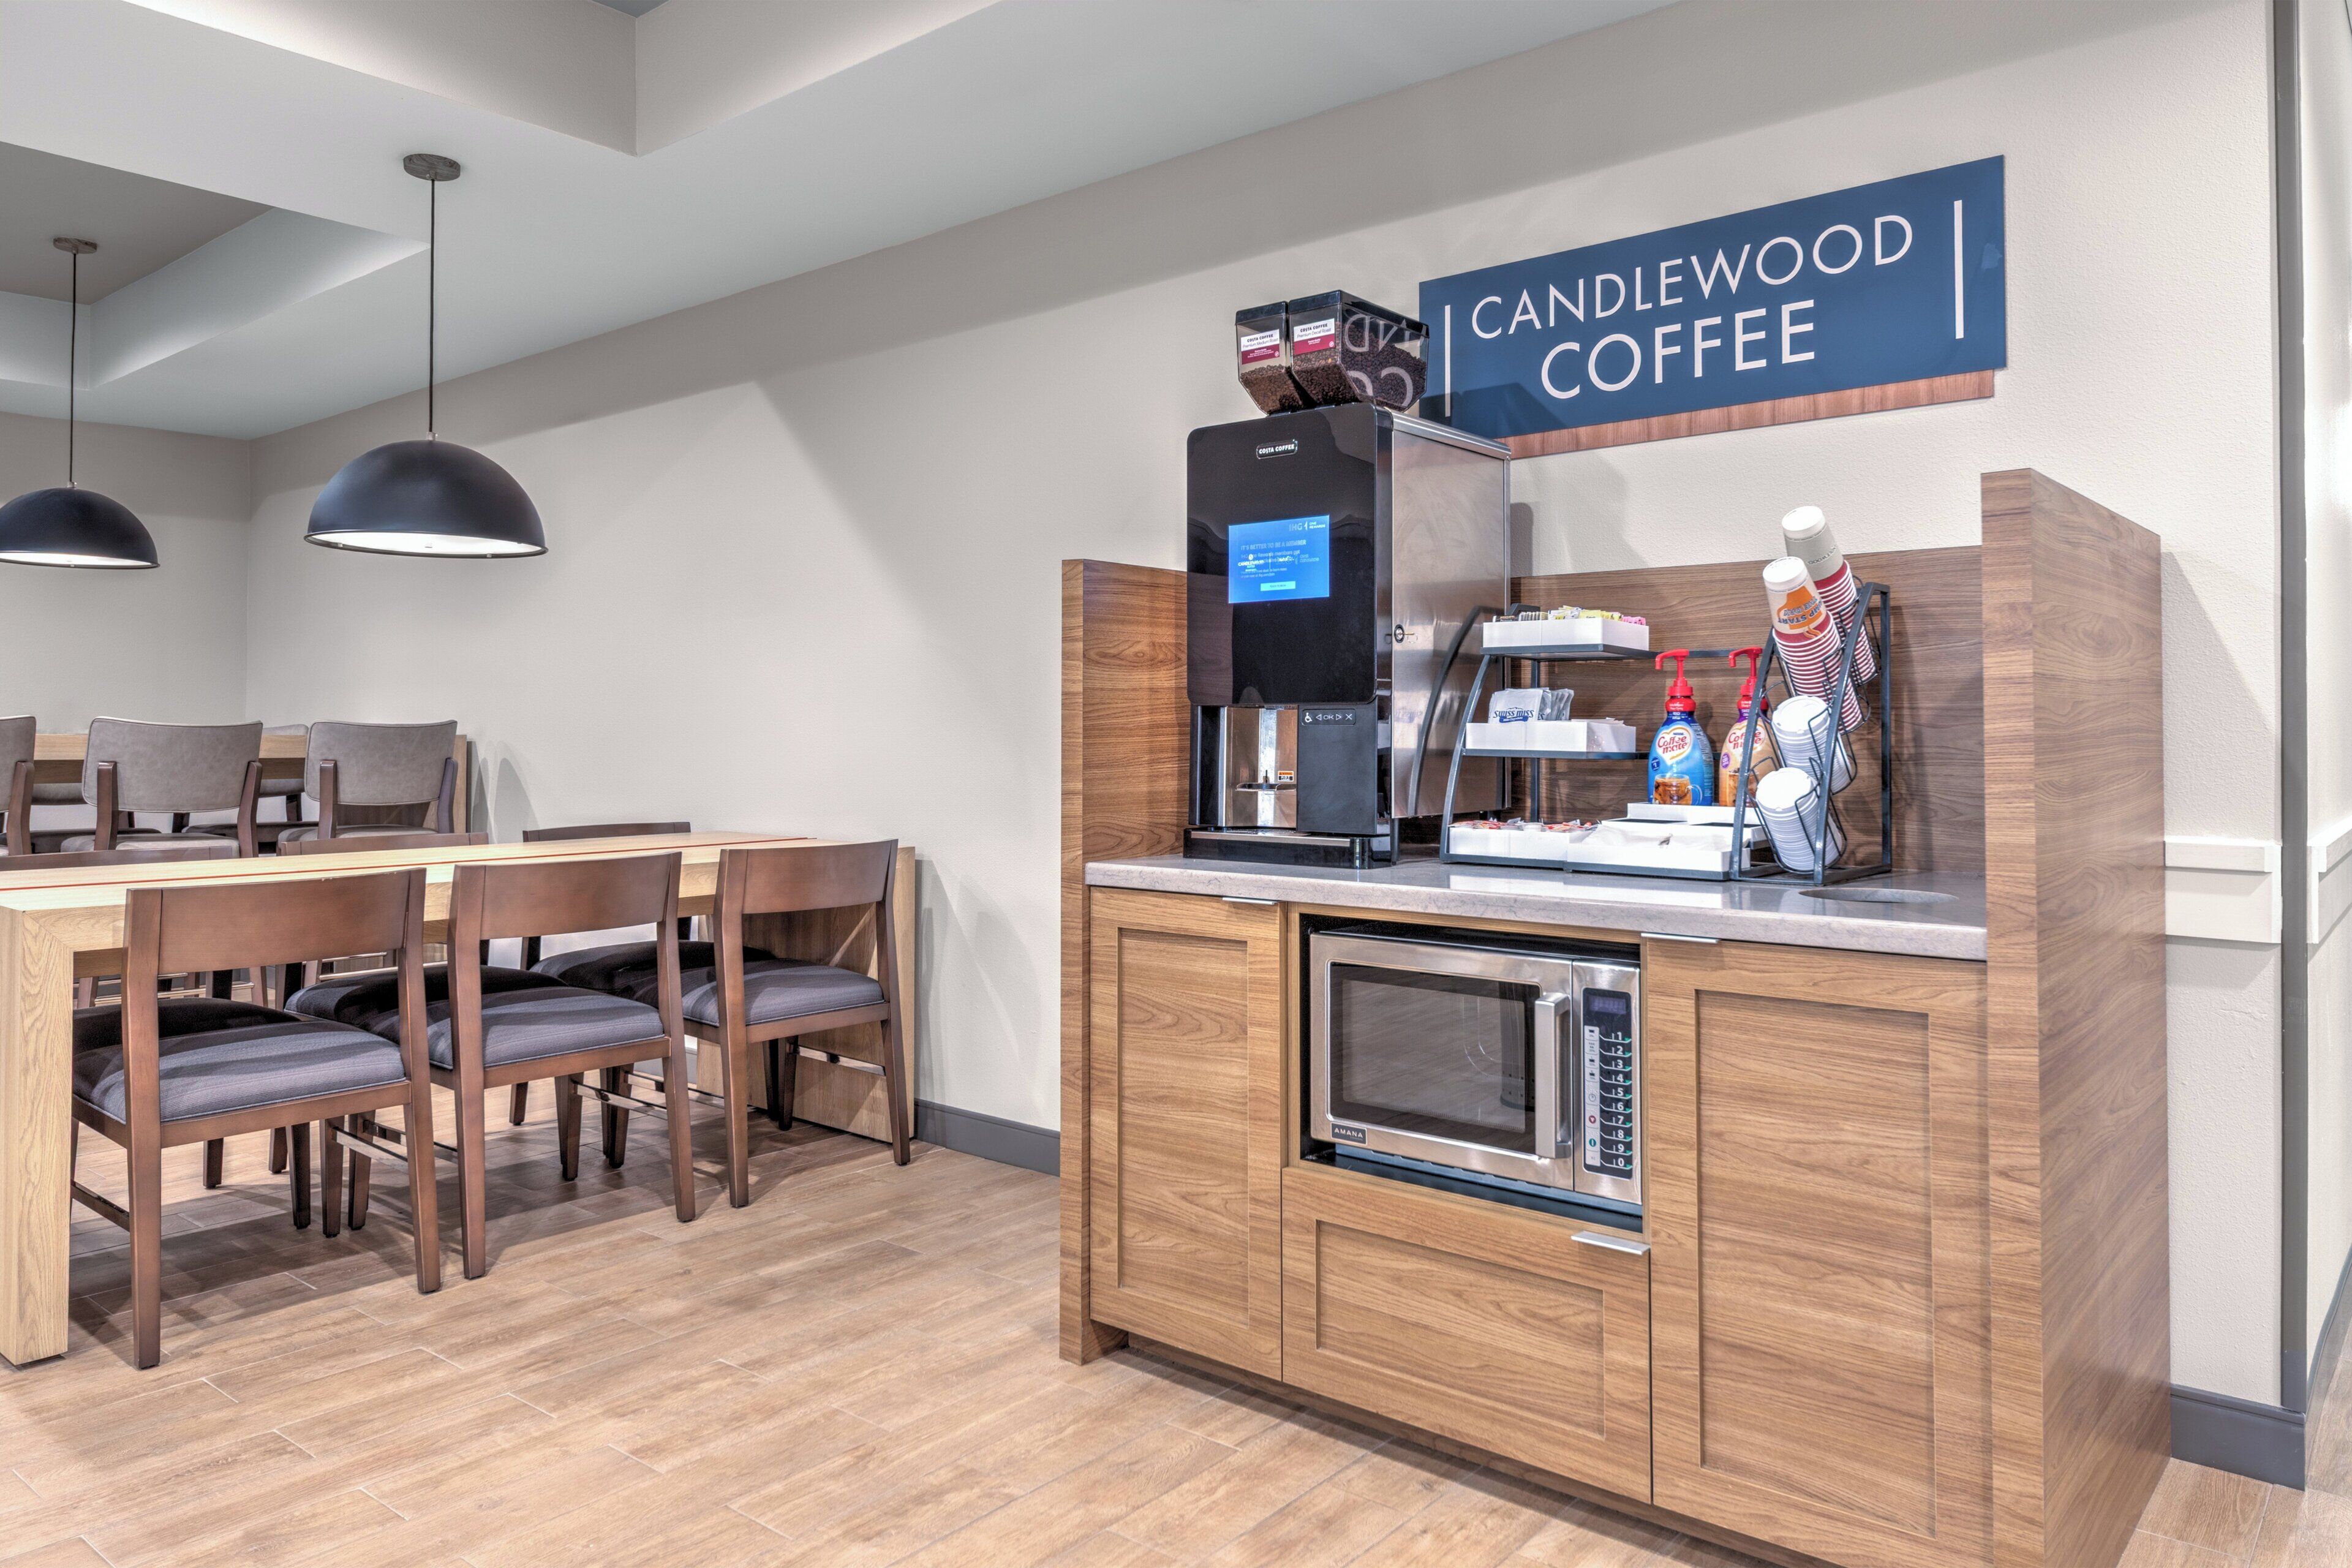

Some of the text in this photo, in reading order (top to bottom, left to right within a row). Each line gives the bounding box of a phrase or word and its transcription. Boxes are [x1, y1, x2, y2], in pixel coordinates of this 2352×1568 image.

[1472, 215, 1913, 339] CANDLEWOOD
[1541, 300, 1815, 399] COFFEE
[1777, 614, 1807, 624] START
[1657, 736, 1687, 748] Coffee
[1616, 1031, 1623, 1041] 1
[1616, 1046, 1623, 1055] 2
[1616, 1059, 1623, 1069] 3
[1616, 1074, 1624, 1083] 4
[1617, 1087, 1624, 1096] 5
[1617, 1102, 1624, 1110] 6
[1617, 1115, 1624, 1125] 7
[1334, 1128, 1363, 1139] AMANA
[1617, 1129, 1624, 1139] 8
[1618, 1144, 1624, 1152] 9
[1618, 1158, 1624, 1166] 0
